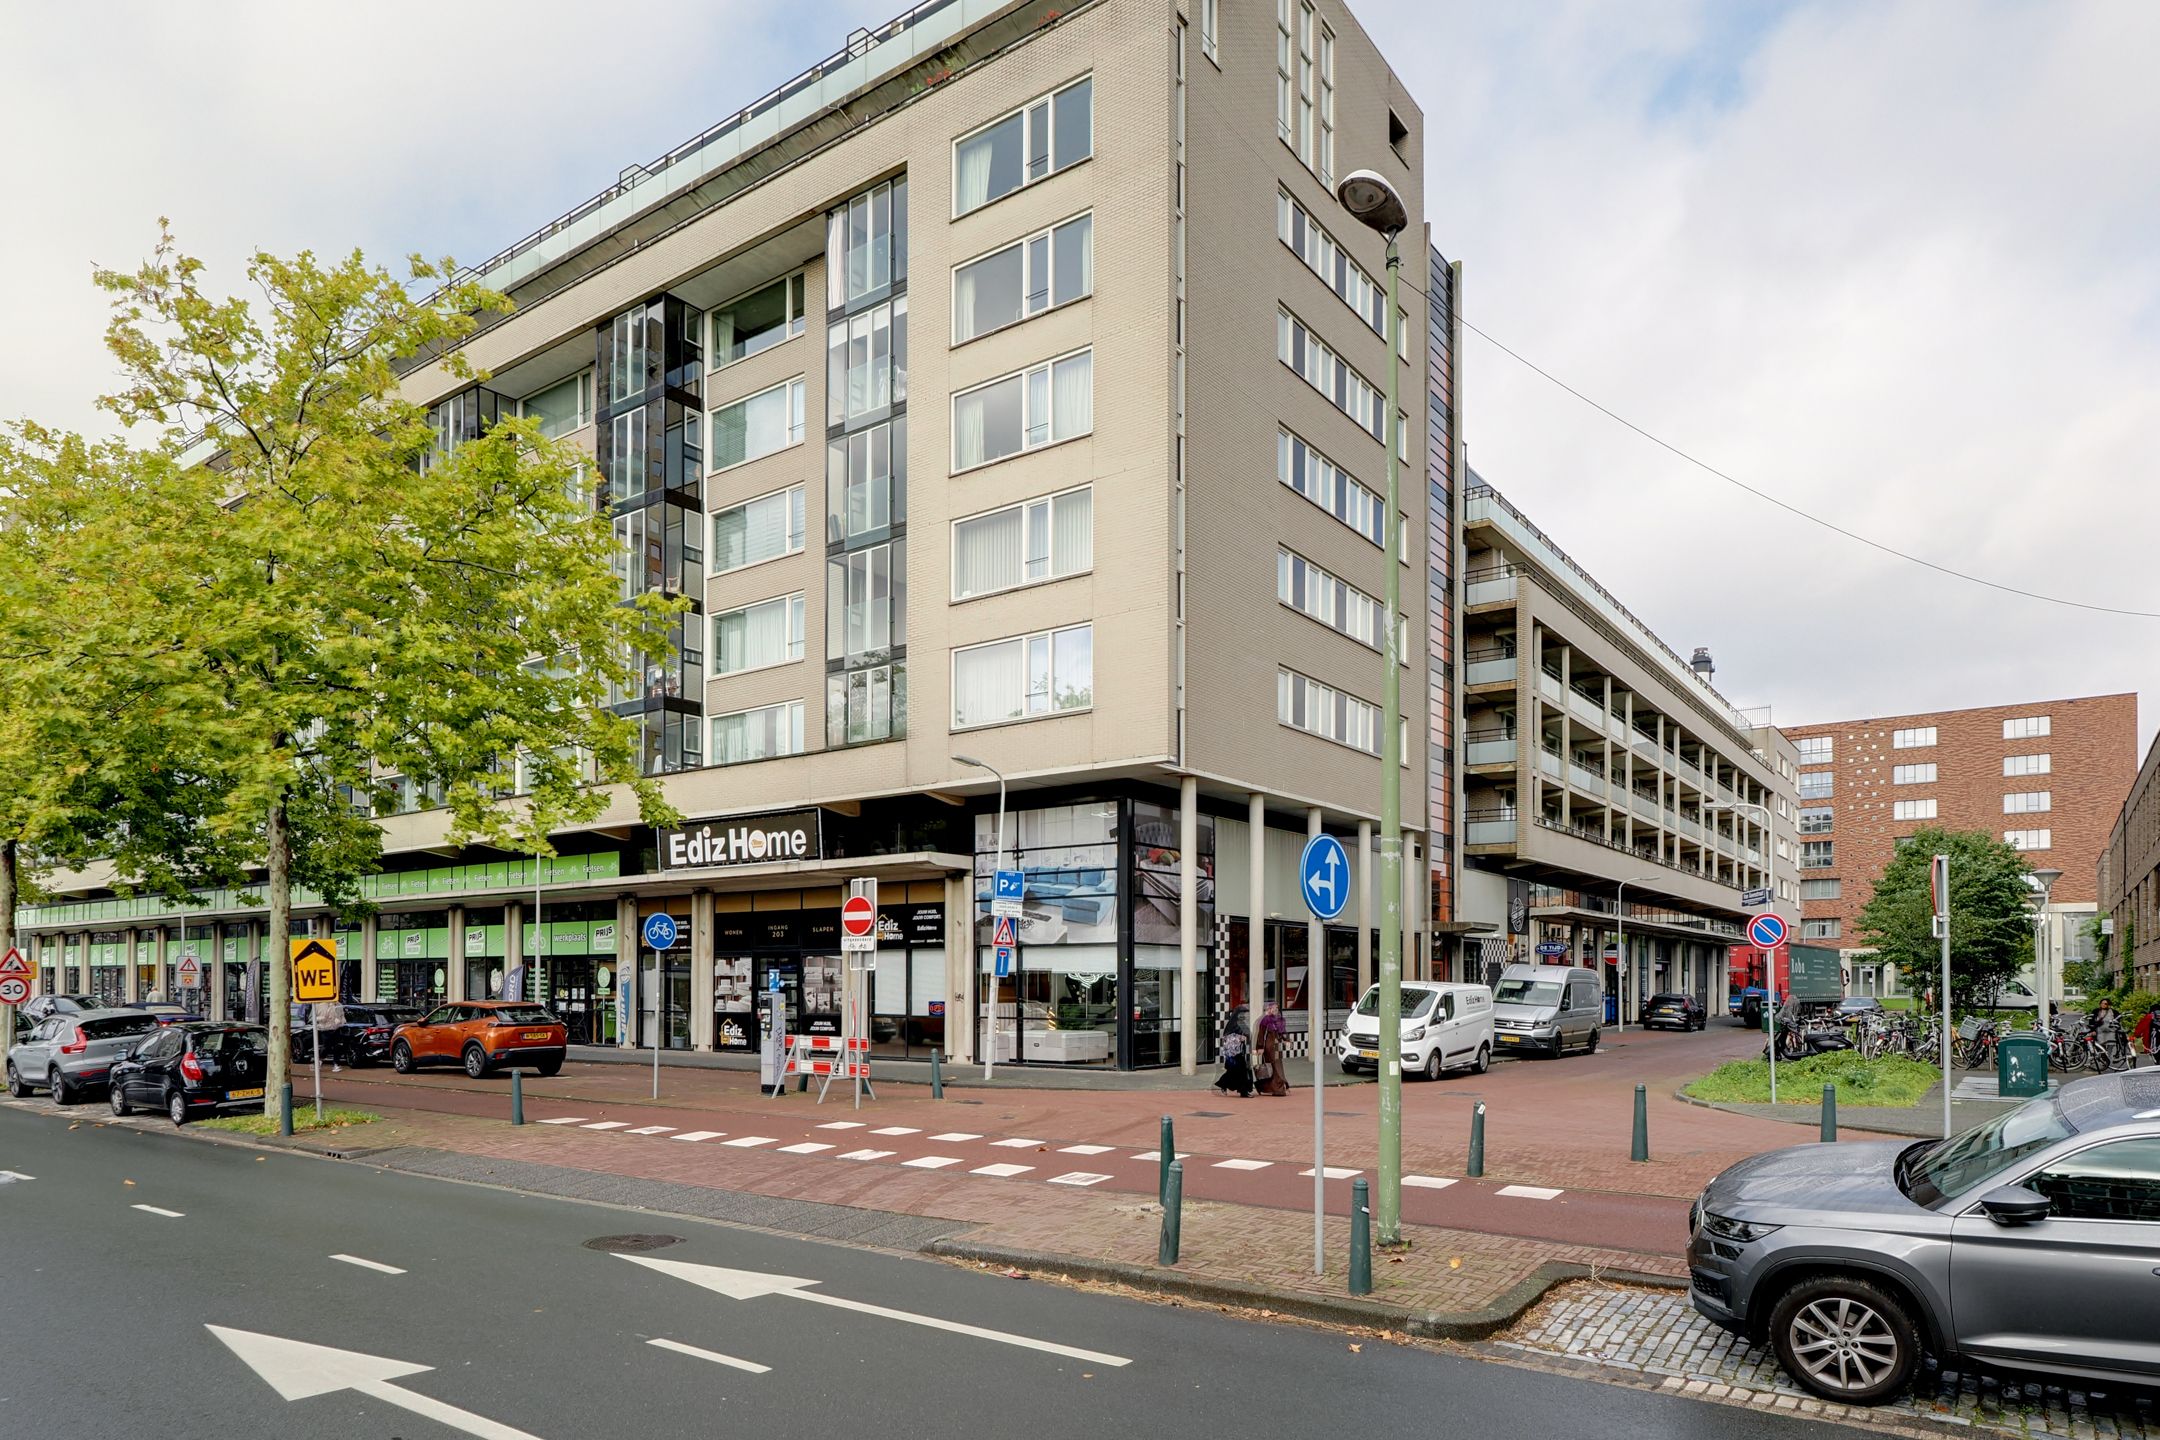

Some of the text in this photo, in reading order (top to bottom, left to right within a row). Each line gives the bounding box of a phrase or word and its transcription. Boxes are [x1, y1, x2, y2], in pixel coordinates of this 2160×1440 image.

[1000, 879, 1009, 891] P
[878, 919, 898, 931] Ediz
[468, 931, 483, 941] PRIJS
[595, 926, 613, 937] PRIJS
[884, 932, 903, 940] Home
[407, 933, 420, 943] PRIJS
[553, 932, 586, 944] werkplaats
[301, 969, 331, 986] WE
[2, 984, 24, 995] 30
[724, 1024, 743, 1036] Ediz
[730, 1037, 747, 1046] Home
